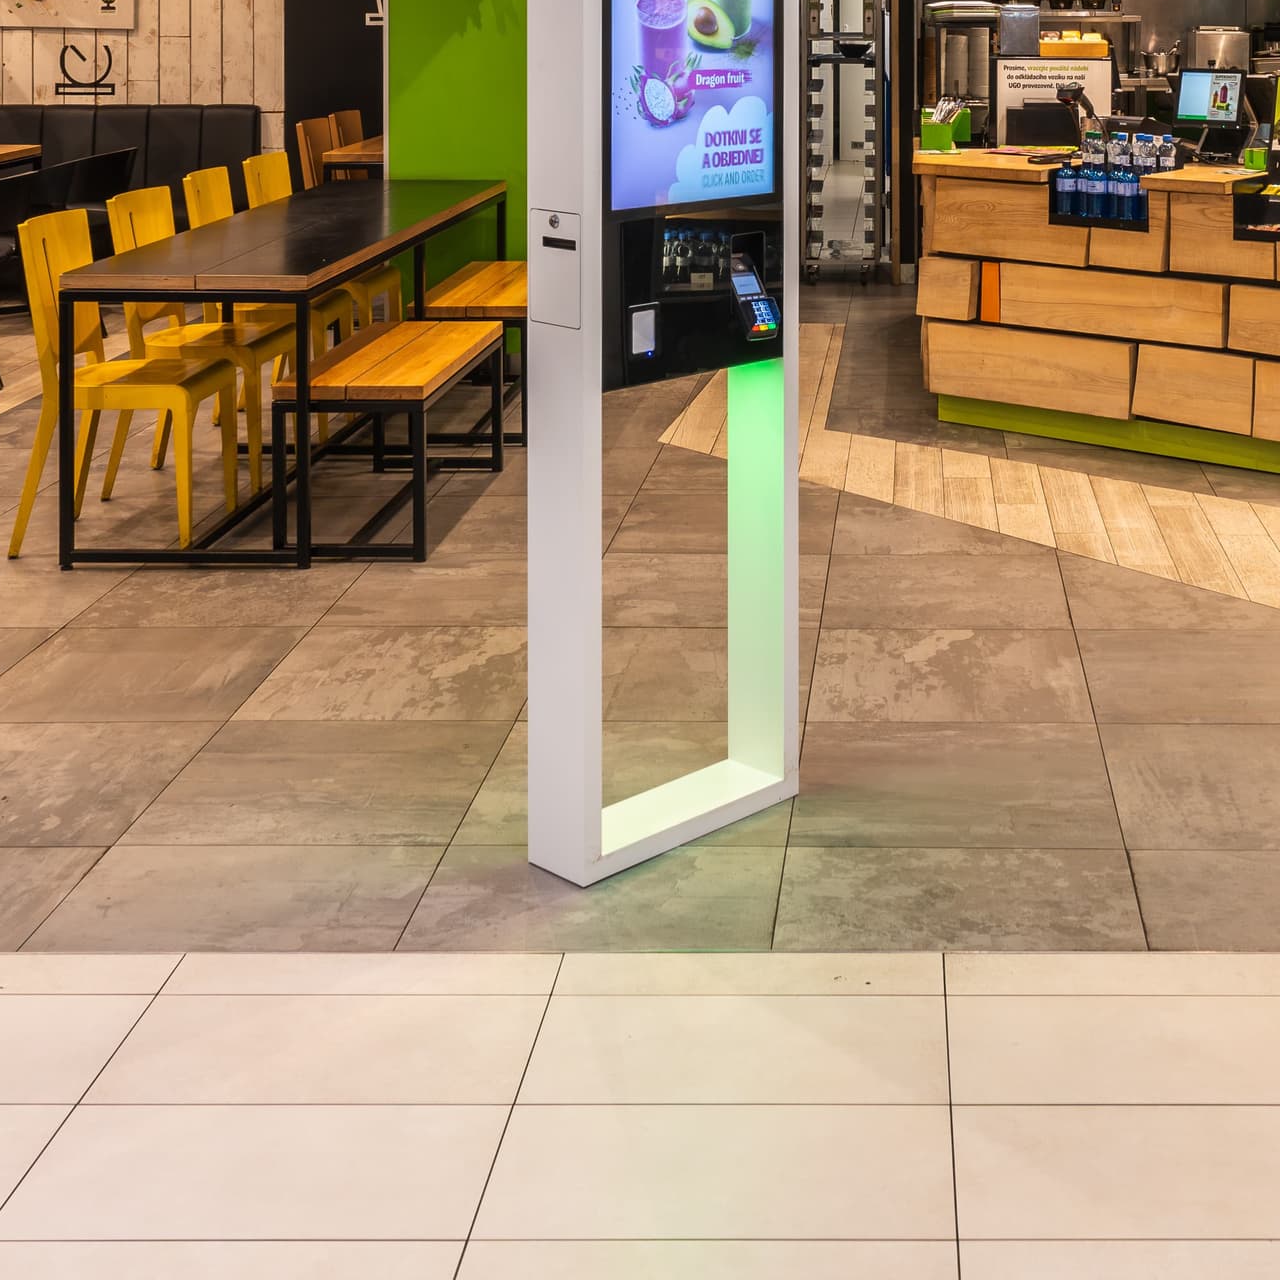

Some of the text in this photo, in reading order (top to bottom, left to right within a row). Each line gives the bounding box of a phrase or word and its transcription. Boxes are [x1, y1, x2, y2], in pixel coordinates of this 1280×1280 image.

[696, 71, 745, 88] Dragon fruit
[705, 128, 762, 148] DOTKNI SE
[702, 153, 711, 169] A
[724, 172, 740, 186] AND
